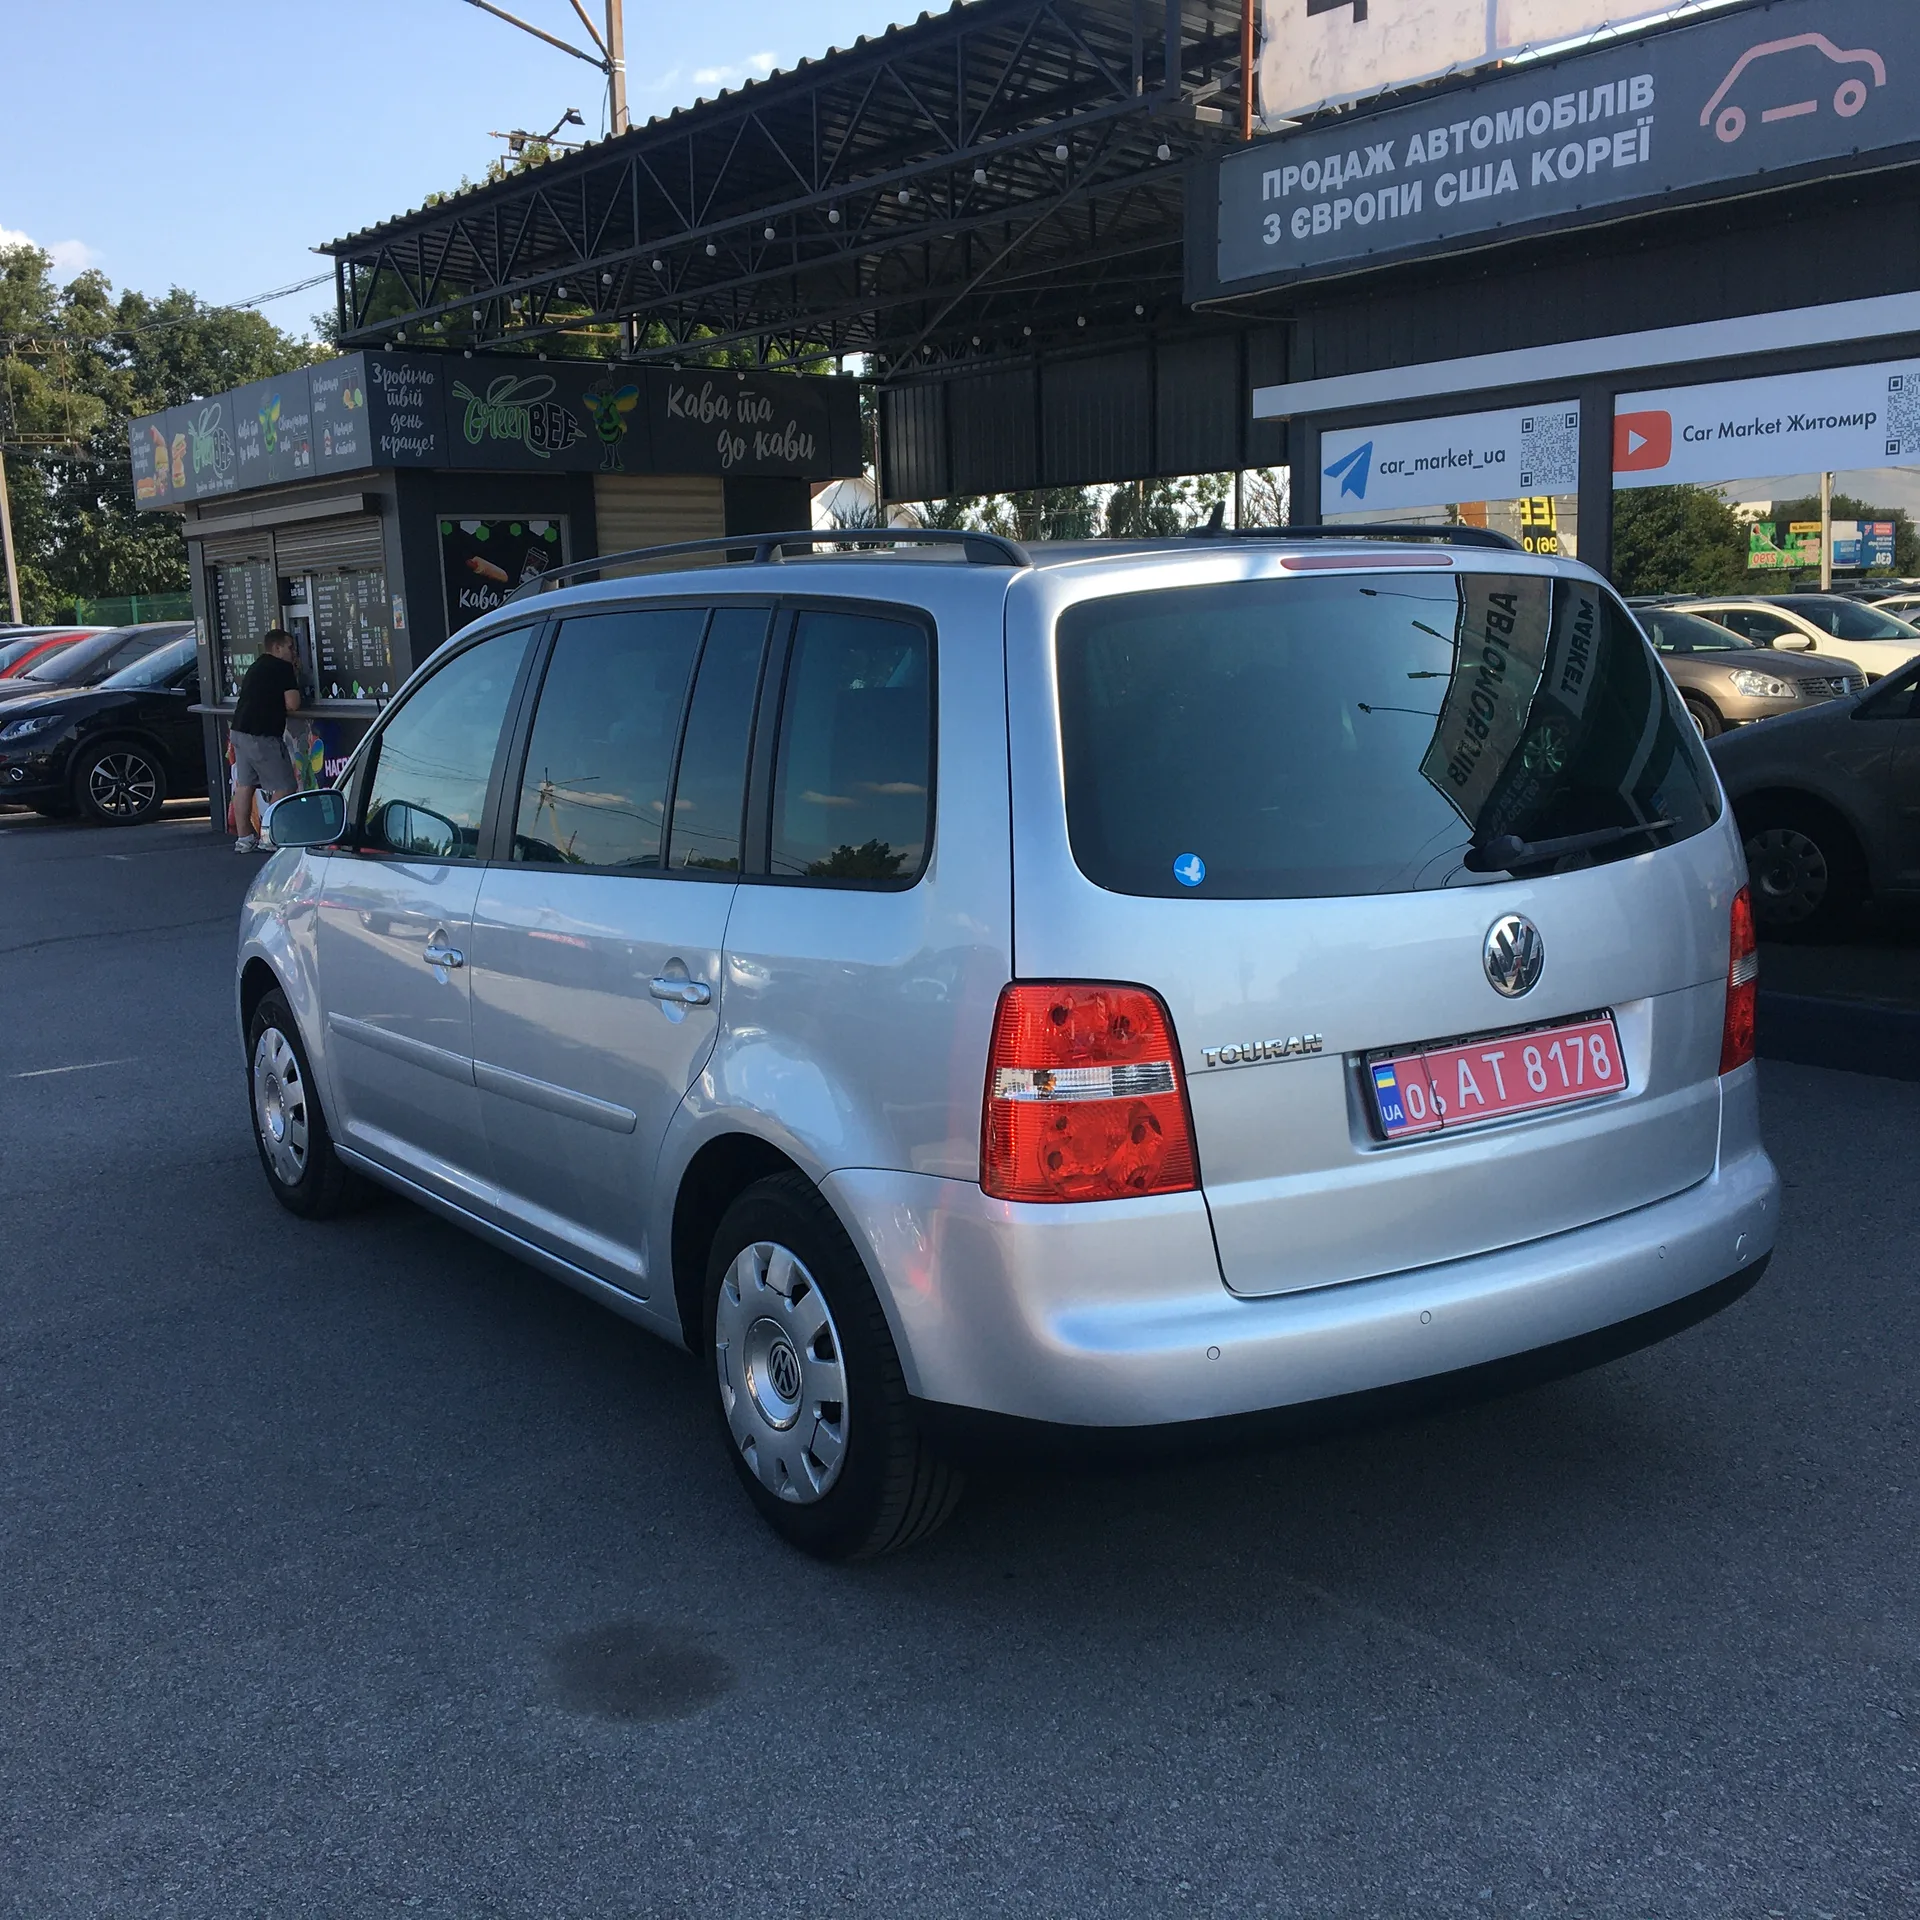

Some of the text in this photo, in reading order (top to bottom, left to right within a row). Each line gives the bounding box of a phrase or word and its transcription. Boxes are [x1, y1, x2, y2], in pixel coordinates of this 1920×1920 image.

[1263, 74, 1655, 200] ПРОДАЖ АВТОМОБІЛІВ
[1263, 115, 1654, 245] З ЄВРОПИ США КОРЕЇ
[372, 362, 435, 391] Зробимо
[387, 385, 423, 407] твій
[667, 381, 774, 424] Кава та
[390, 413, 424, 434] день
[1683, 411, 1877, 442] Car Market Житомир
[380, 434, 435, 459] краще!
[717, 420, 816, 468] до кави
[1380, 448, 1506, 476] car_market_ua
[459, 584, 500, 610] Кава
[1201, 1032, 1323, 1067] TOURAN
[1405, 1033, 1612, 1120] 06 AT 8178
[1383, 1103, 1404, 1122] UA
